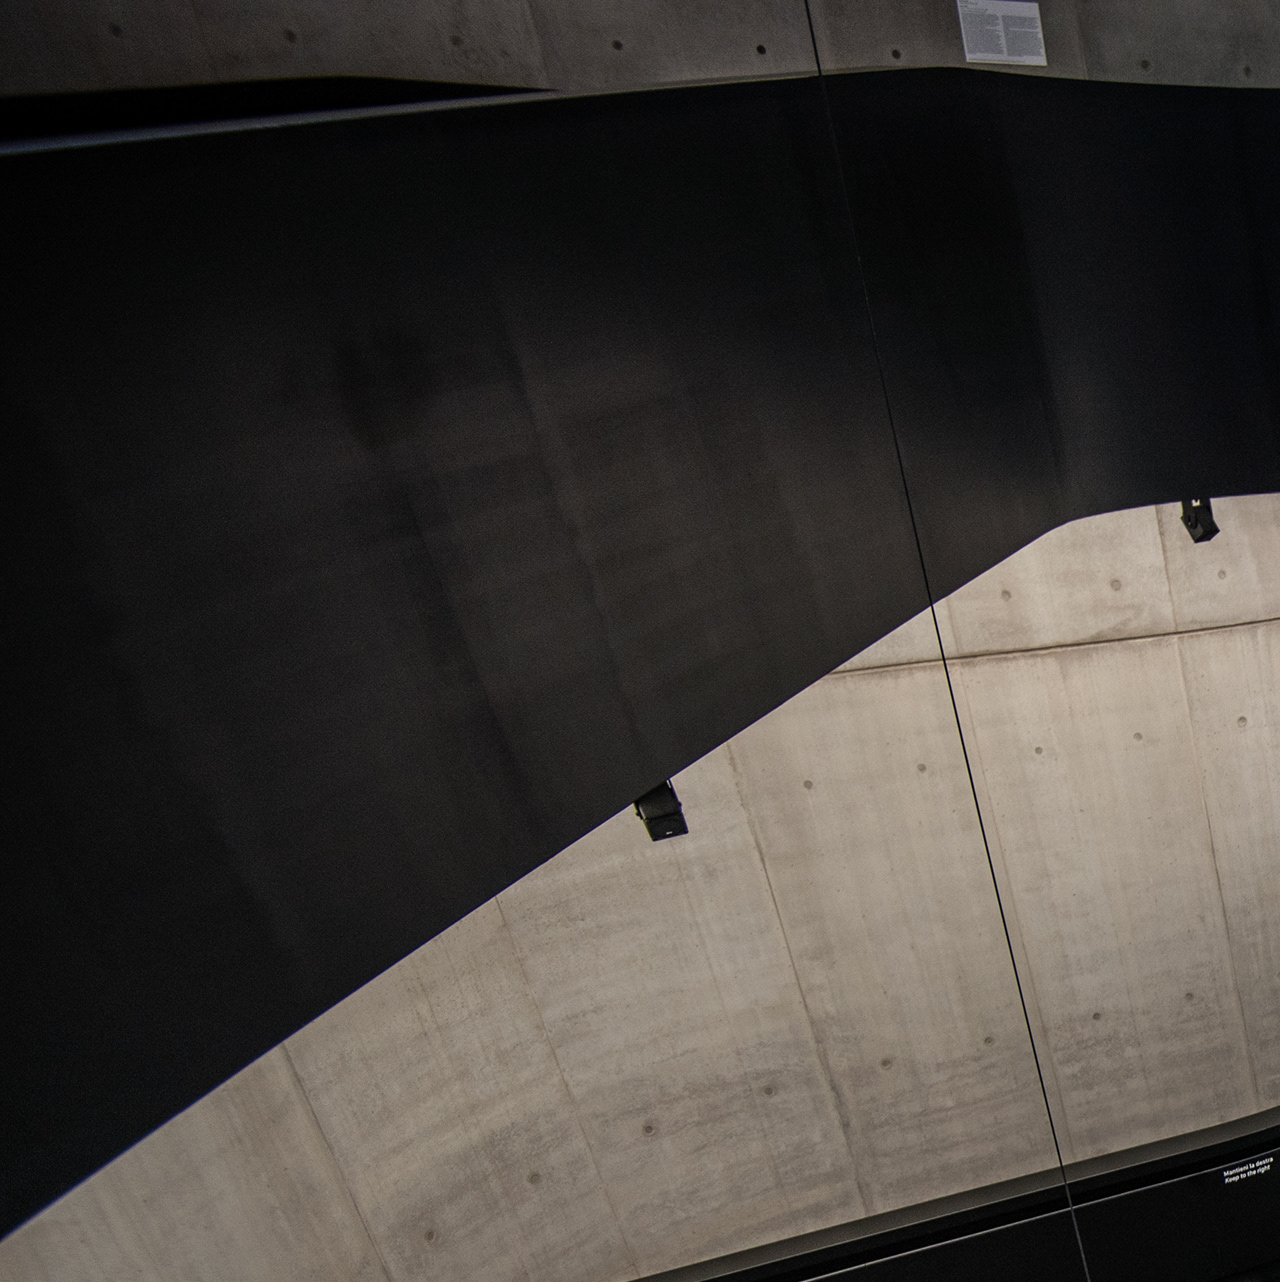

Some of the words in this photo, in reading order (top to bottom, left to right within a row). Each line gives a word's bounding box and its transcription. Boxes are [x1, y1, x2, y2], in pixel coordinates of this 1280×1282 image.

[1256, 1157, 1274, 1167] destra
[1225, 1175, 1240, 1184] Keep
[1257, 1164, 1271, 1174] right
